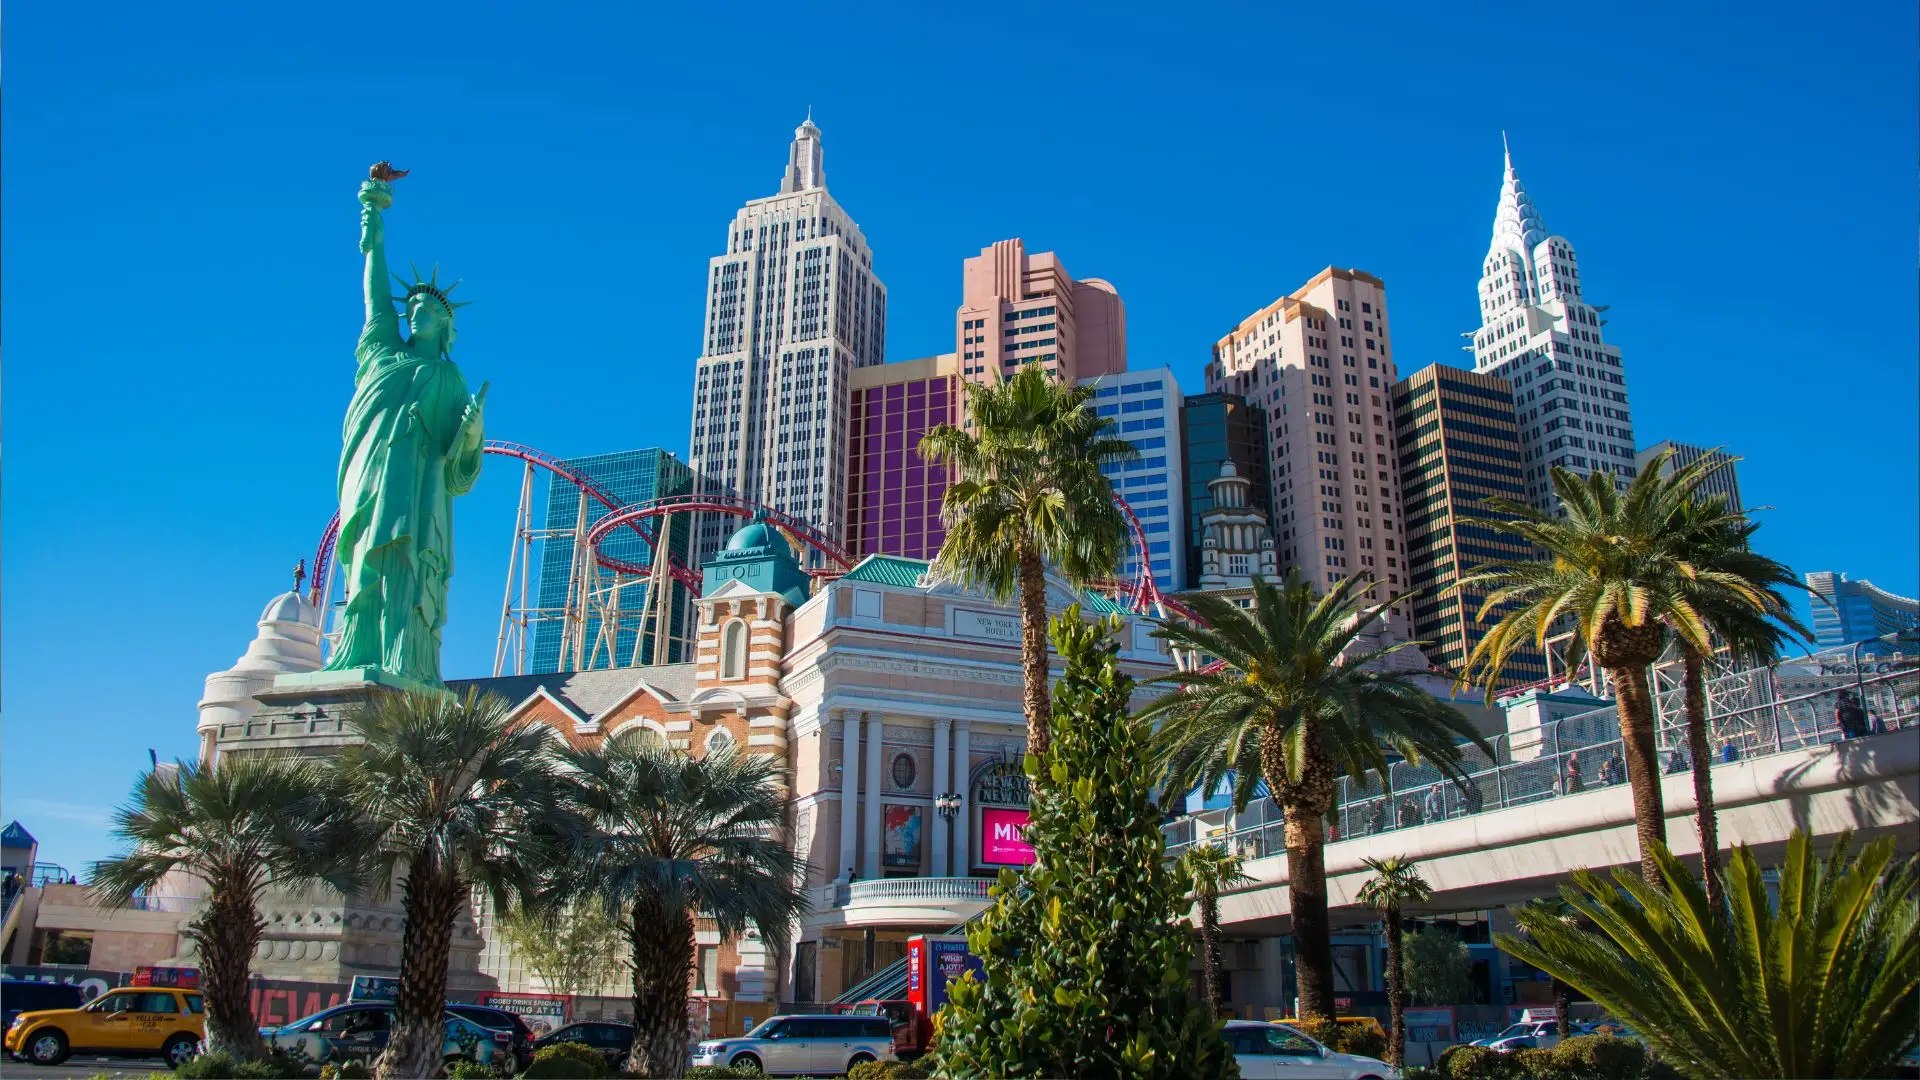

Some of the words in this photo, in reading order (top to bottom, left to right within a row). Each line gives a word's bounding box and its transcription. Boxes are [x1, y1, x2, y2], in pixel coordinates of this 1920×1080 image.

[976, 617, 992, 627] NEW
[994, 619, 1013, 629] YORK
[985, 626, 1006, 636] HOTEL
[983, 774, 1014, 788] NEW
[983, 789, 1014, 802] NEW
